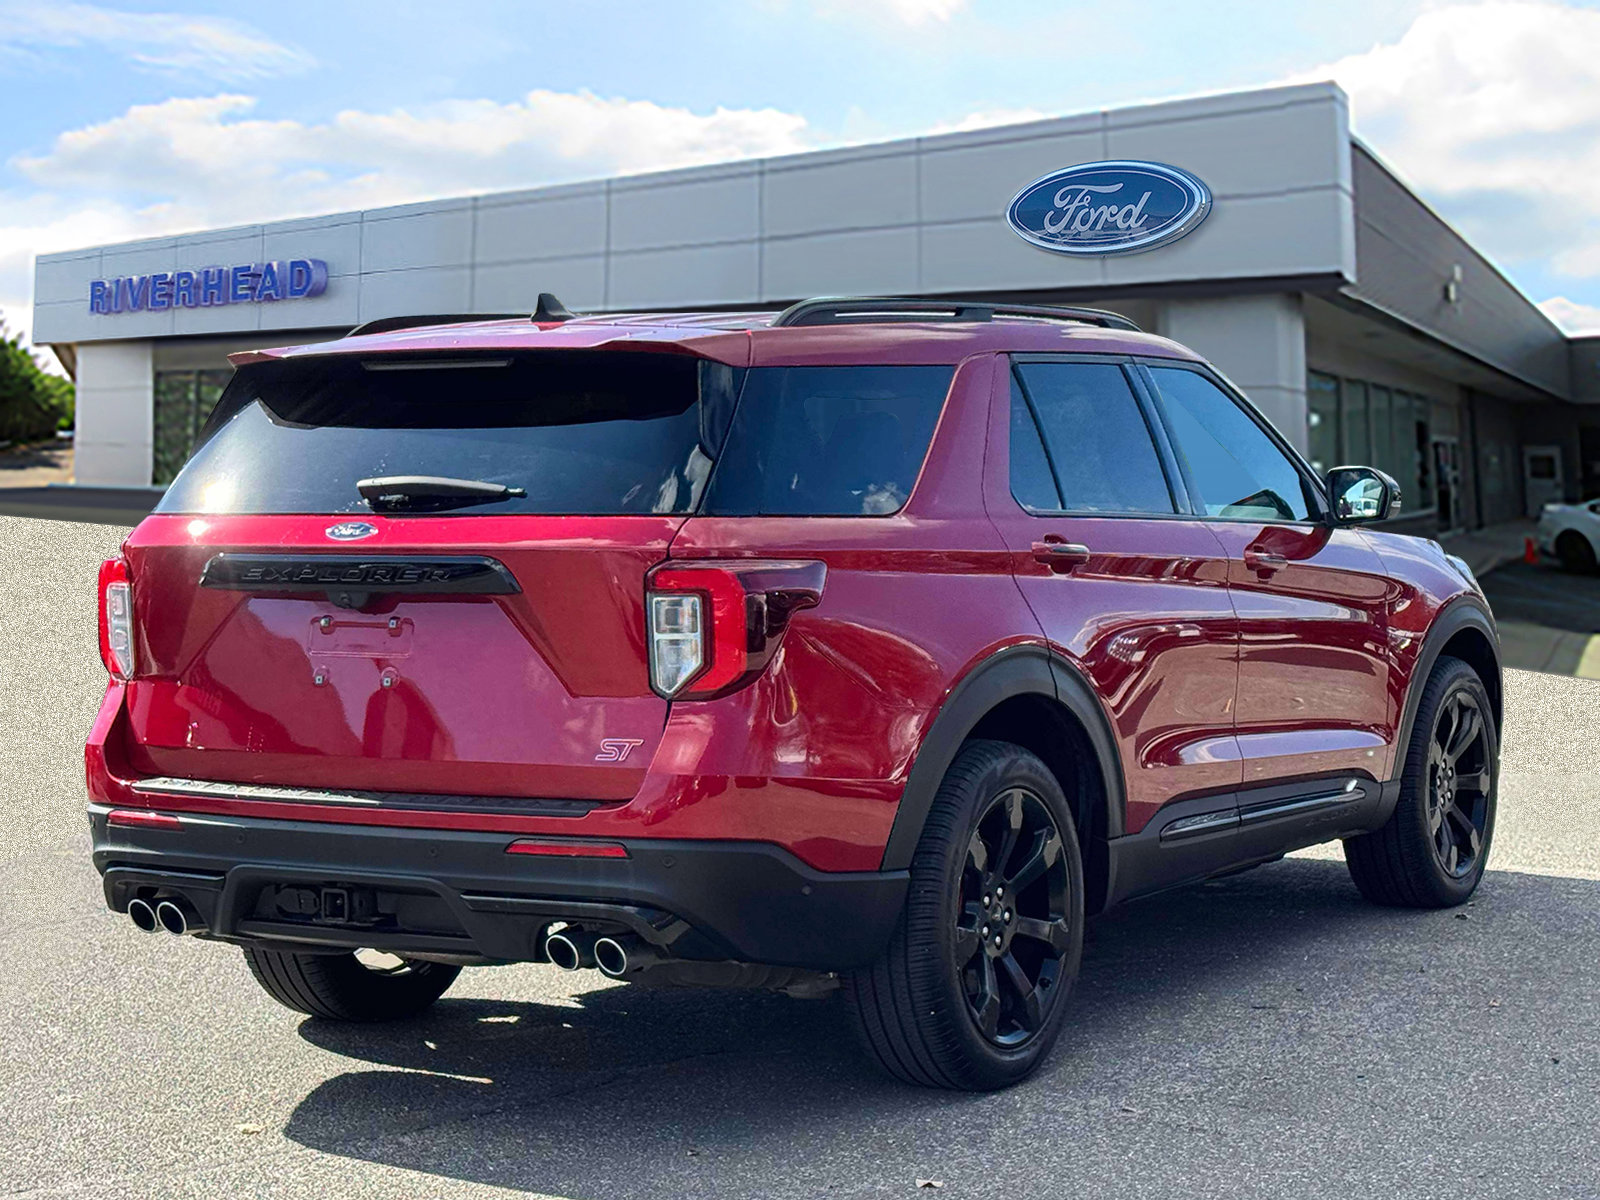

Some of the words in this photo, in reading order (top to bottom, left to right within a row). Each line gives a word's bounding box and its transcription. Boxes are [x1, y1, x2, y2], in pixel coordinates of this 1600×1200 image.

[1043, 182, 1152, 234] Ford
[89, 259, 326, 314] RIVERHEAD
[240, 566, 451, 583] EXPLORER
[594, 738, 645, 762] ST
